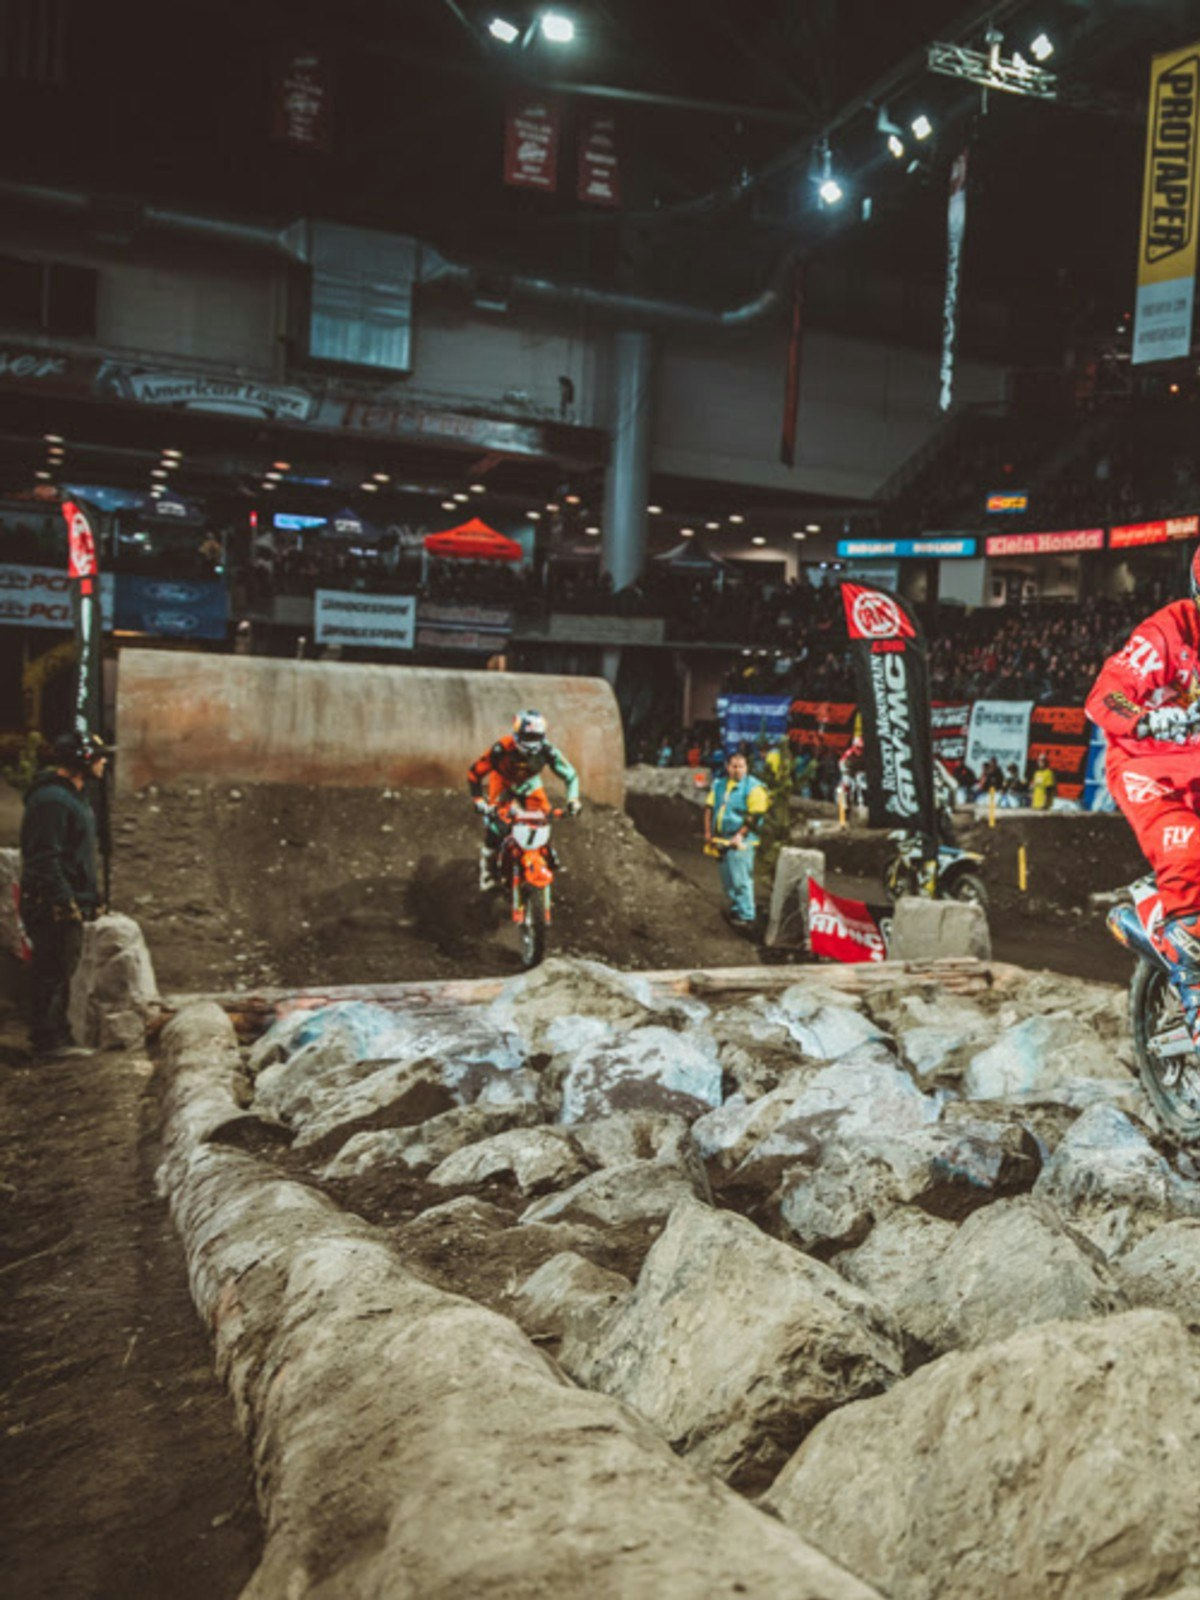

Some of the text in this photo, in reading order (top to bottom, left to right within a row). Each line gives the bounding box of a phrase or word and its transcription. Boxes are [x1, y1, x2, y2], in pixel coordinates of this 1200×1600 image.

[1150, 71, 1193, 249] PROTAPER
[141, 379, 240, 401] American
[988, 538, 1035, 554] Klein
[1037, 533, 1100, 551] Honda
[1123, 634, 1163, 681] FLY
[1163, 826, 1195, 845] FLY
